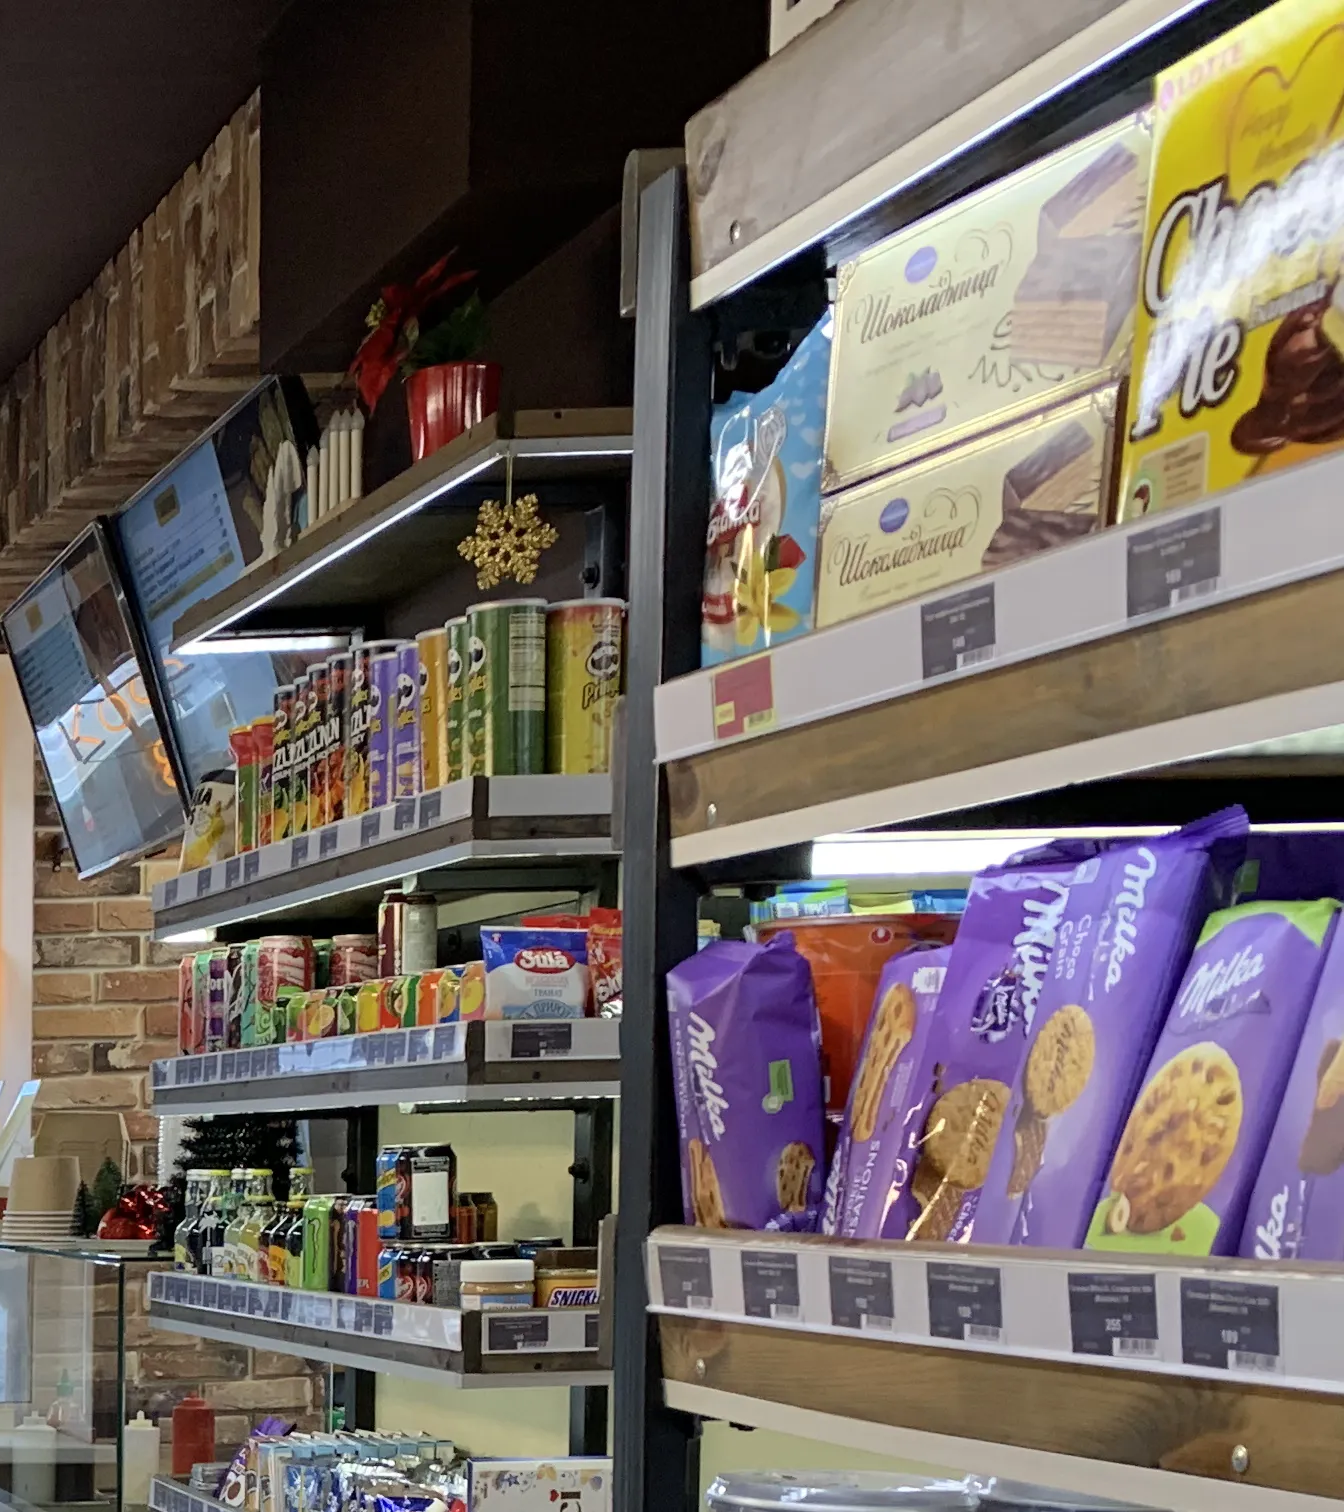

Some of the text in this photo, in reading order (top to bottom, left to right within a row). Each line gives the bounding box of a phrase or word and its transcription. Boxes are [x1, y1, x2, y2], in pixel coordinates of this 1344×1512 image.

[853, 263, 1000, 345] Шоколадница
[833, 522, 973, 587] Шоколадница
[1054, 921, 1074, 979] Grain
[1066, 913, 1092, 980] Choco
[1104, 846, 1158, 994] Milka
[1178, 944, 1266, 1019] Milka
[687, 1010, 730, 1142] Milka
[1255, 1184, 1289, 1260] lka
